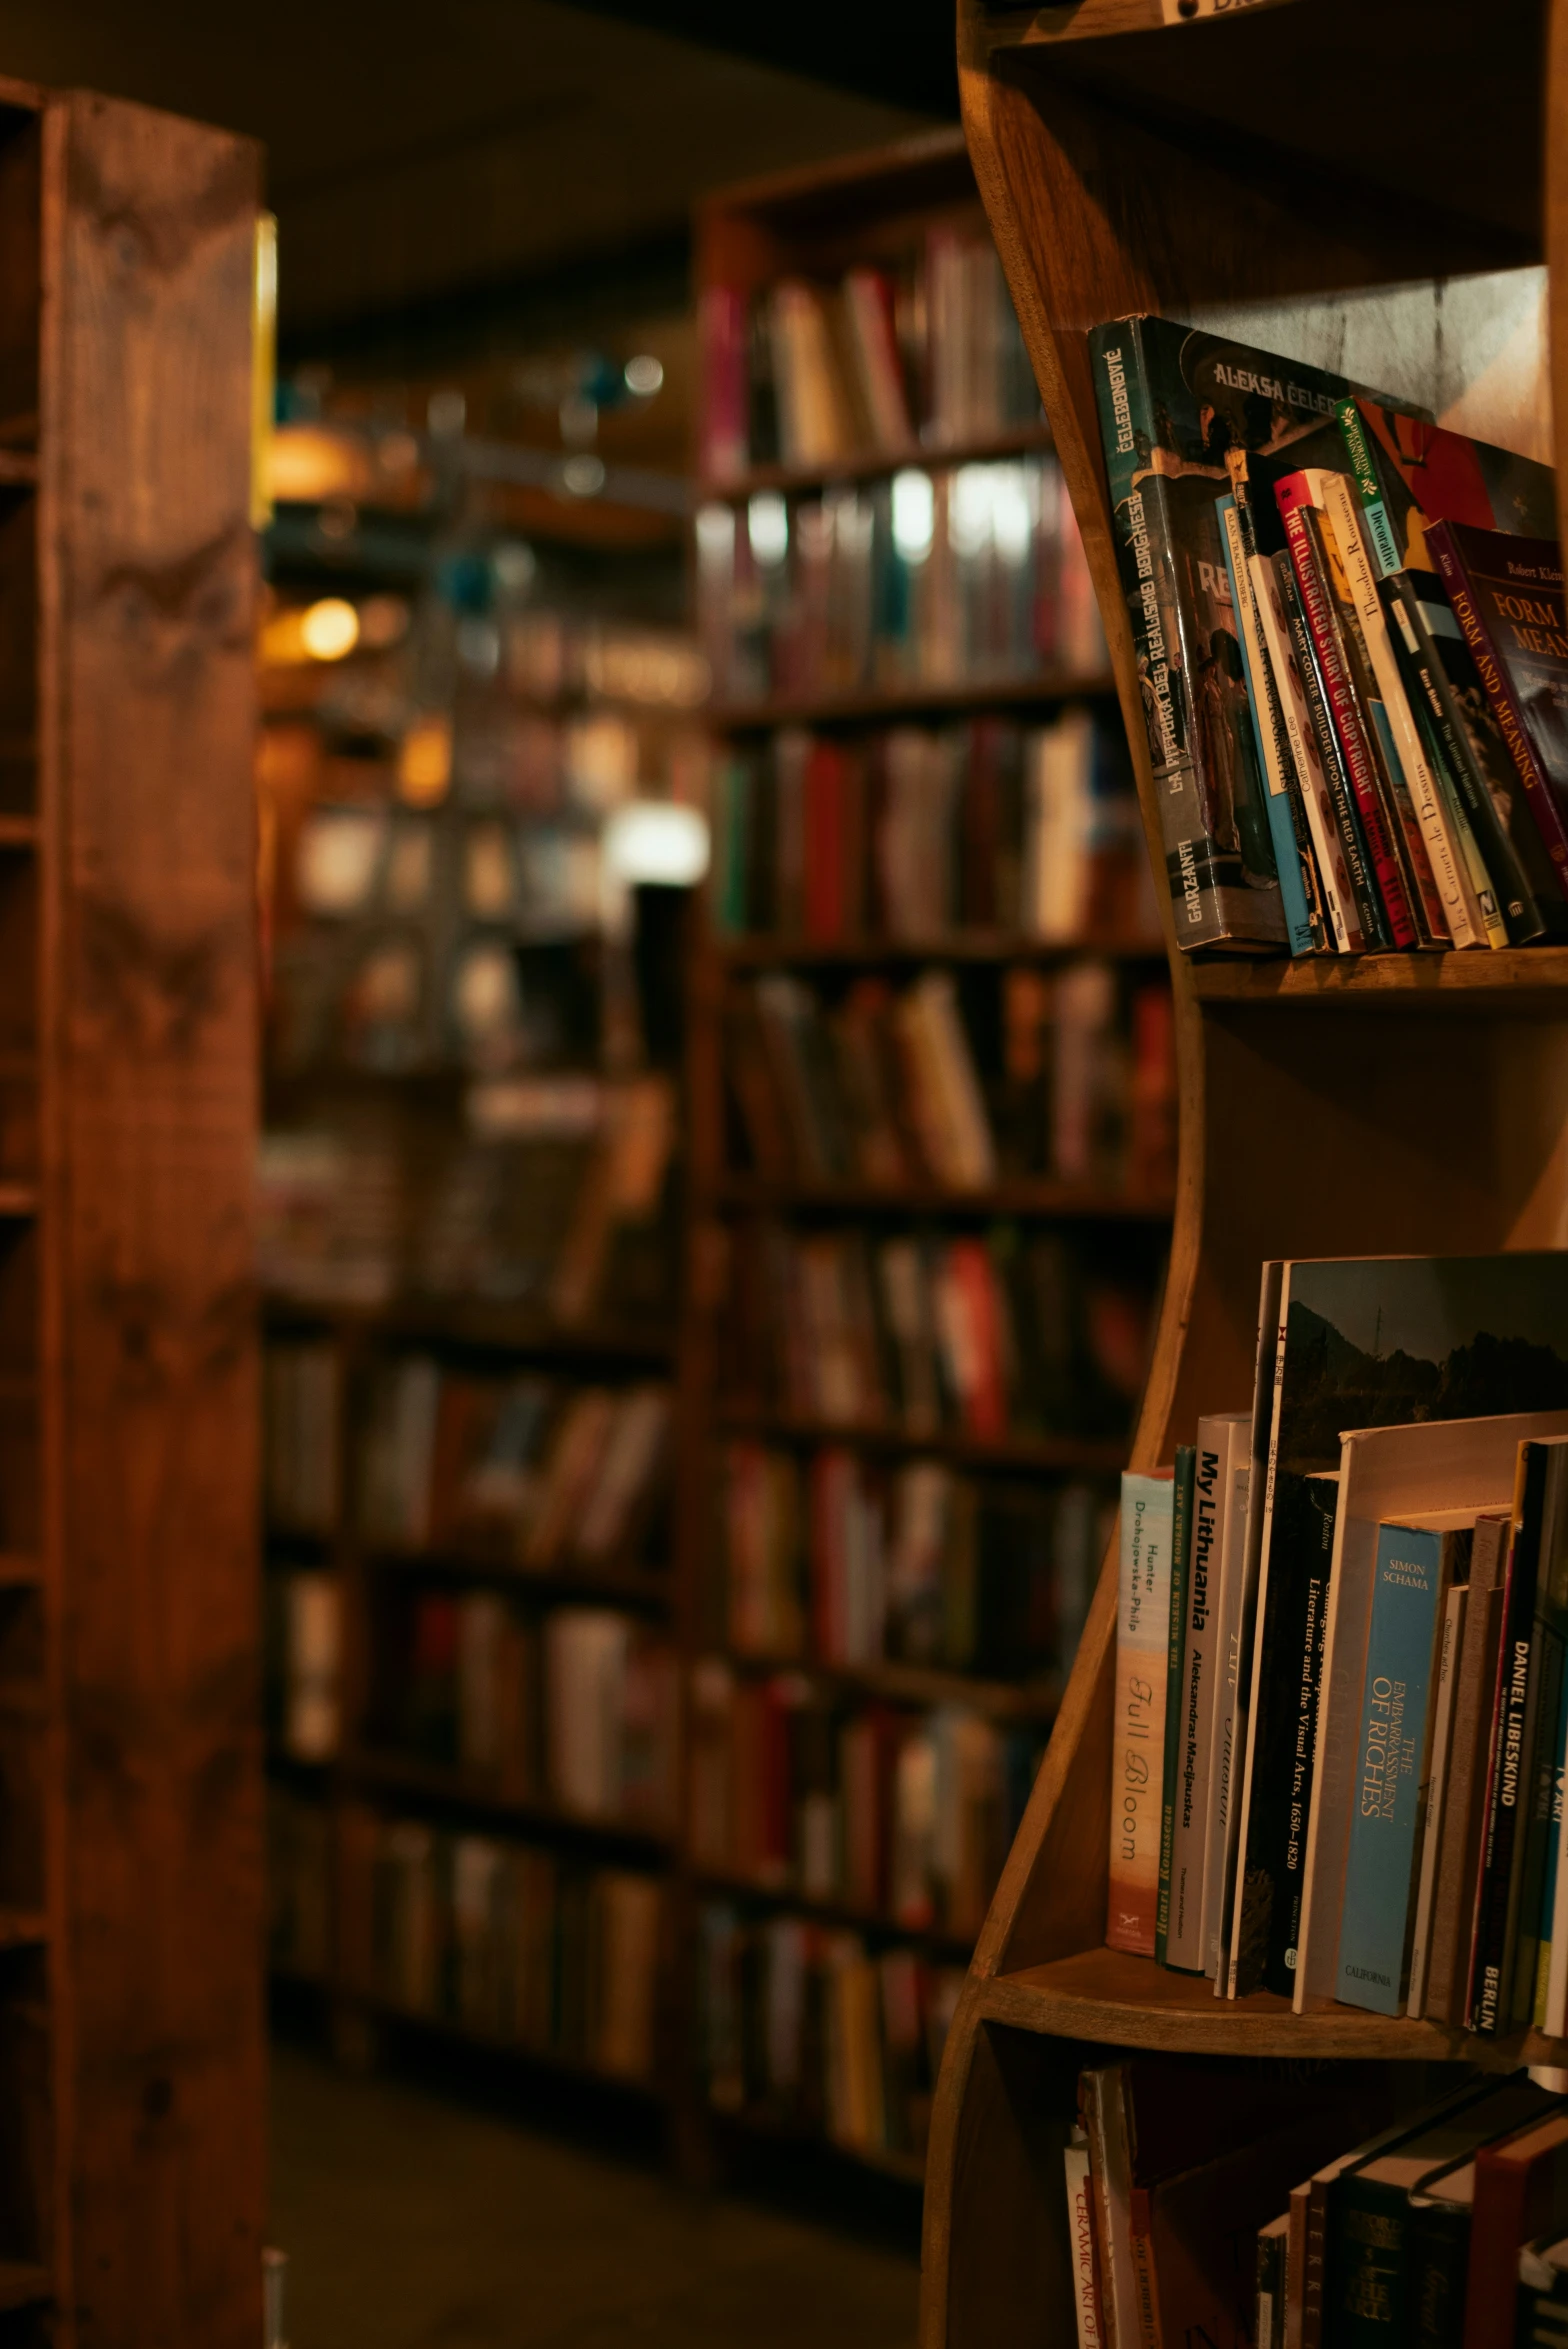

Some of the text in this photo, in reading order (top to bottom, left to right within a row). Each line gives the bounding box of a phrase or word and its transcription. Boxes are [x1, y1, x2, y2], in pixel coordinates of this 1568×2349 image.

[1102, 348, 1134, 454] ČELEBONOVIĆ
[1213, 362, 1285, 402] ALEKSA
[1346, 433, 1361, 475] PAINTING
[1350, 423, 1372, 478] DECORATIVE
[1126, 492, 1153, 579] BORGHESE
[1339, 492, 1362, 556] Rousseau
[1371, 510, 1395, 569] Decorative
[1227, 513, 1248, 608] ALAN TRACHTENBERG
[1280, 562, 1294, 602] GRATTAN
[1439, 553, 1453, 577] Klein
[1506, 560, 1537, 579] Robert
[1139, 580, 1166, 662] REALISMO
[1490, 591, 1561, 628] FORM
[1284, 507, 1373, 796] THE ILLUSTRATED STORY OF COPYRIGHT
[1152, 661, 1169, 699] DEL
[1452, 590, 1539, 790] FORM AND MEANING
[1287, 716, 1311, 793] Catherine Lee
[1293, 618, 1365, 887] MARY COLTER: BUILDER UPON THE RED EARTH
[1419, 667, 1431, 689] Ezra
[1427, 687, 1444, 718] Stoller
[1442, 723, 1453, 742] The
[1448, 741, 1466, 774] United
[1461, 772, 1479, 810] Nations
[1168, 770, 1184, 795] LA
[1416, 763, 1438, 821] Dessins
[1428, 825, 1443, 842] de
[1178, 839, 1203, 923] GARZANTI
[1301, 866, 1311, 900] amphoto
[1439, 846, 1461, 905] Carnets
[1176, 1484, 1184, 1508] ART
[1174, 1514, 1183, 1565] MODERN
[1192, 1451, 1219, 1631] My Lithuania
[1322, 1512, 1333, 1551] Roston
[1128, 1501, 1145, 1633] Drohojowska-Philp
[1146, 1544, 1158, 1593] Hunter
[1173, 1570, 1181, 1586] OF
[1383, 1571, 1429, 1591] SCHAMA
[1389, 1559, 1426, 1575] SIMON
[1171, 1591, 1180, 1641] MUSEUM
[1305, 1577, 1321, 1653] Literature
[1301, 1655, 1313, 1683] and
[1300, 1684, 1312, 1708] the
[1183, 1648, 1202, 1829] Aleksandras Macijauskas
[1296, 1714, 1310, 1759] Visual
[1361, 1676, 1392, 1818] OF RICHES
[1501, 1640, 1530, 1807] DANIEL LIBESKIND
[1122, 1677, 1152, 1860] Full Bloom
[1382, 1680, 1406, 1823] EMBARRASSMENT
[1400, 1737, 1416, 1775] THE
[1292, 1761, 1306, 1797] Arts,
[1160, 1804, 1172, 1881] Rousseau
[1156, 1889, 1168, 1935] Henri
[1290, 1895, 1299, 1942] PRINCETON
[1345, 1964, 1392, 1988] CALIFORNIA
[1479, 1964, 1500, 2032] BERLIN
[1076, 2193, 1091, 2275] CERAMIC
[1306, 2206, 1325, 2318] TERRE
[1081, 2276, 1095, 2310] ART
[1084, 2314, 1097, 2339] OF
